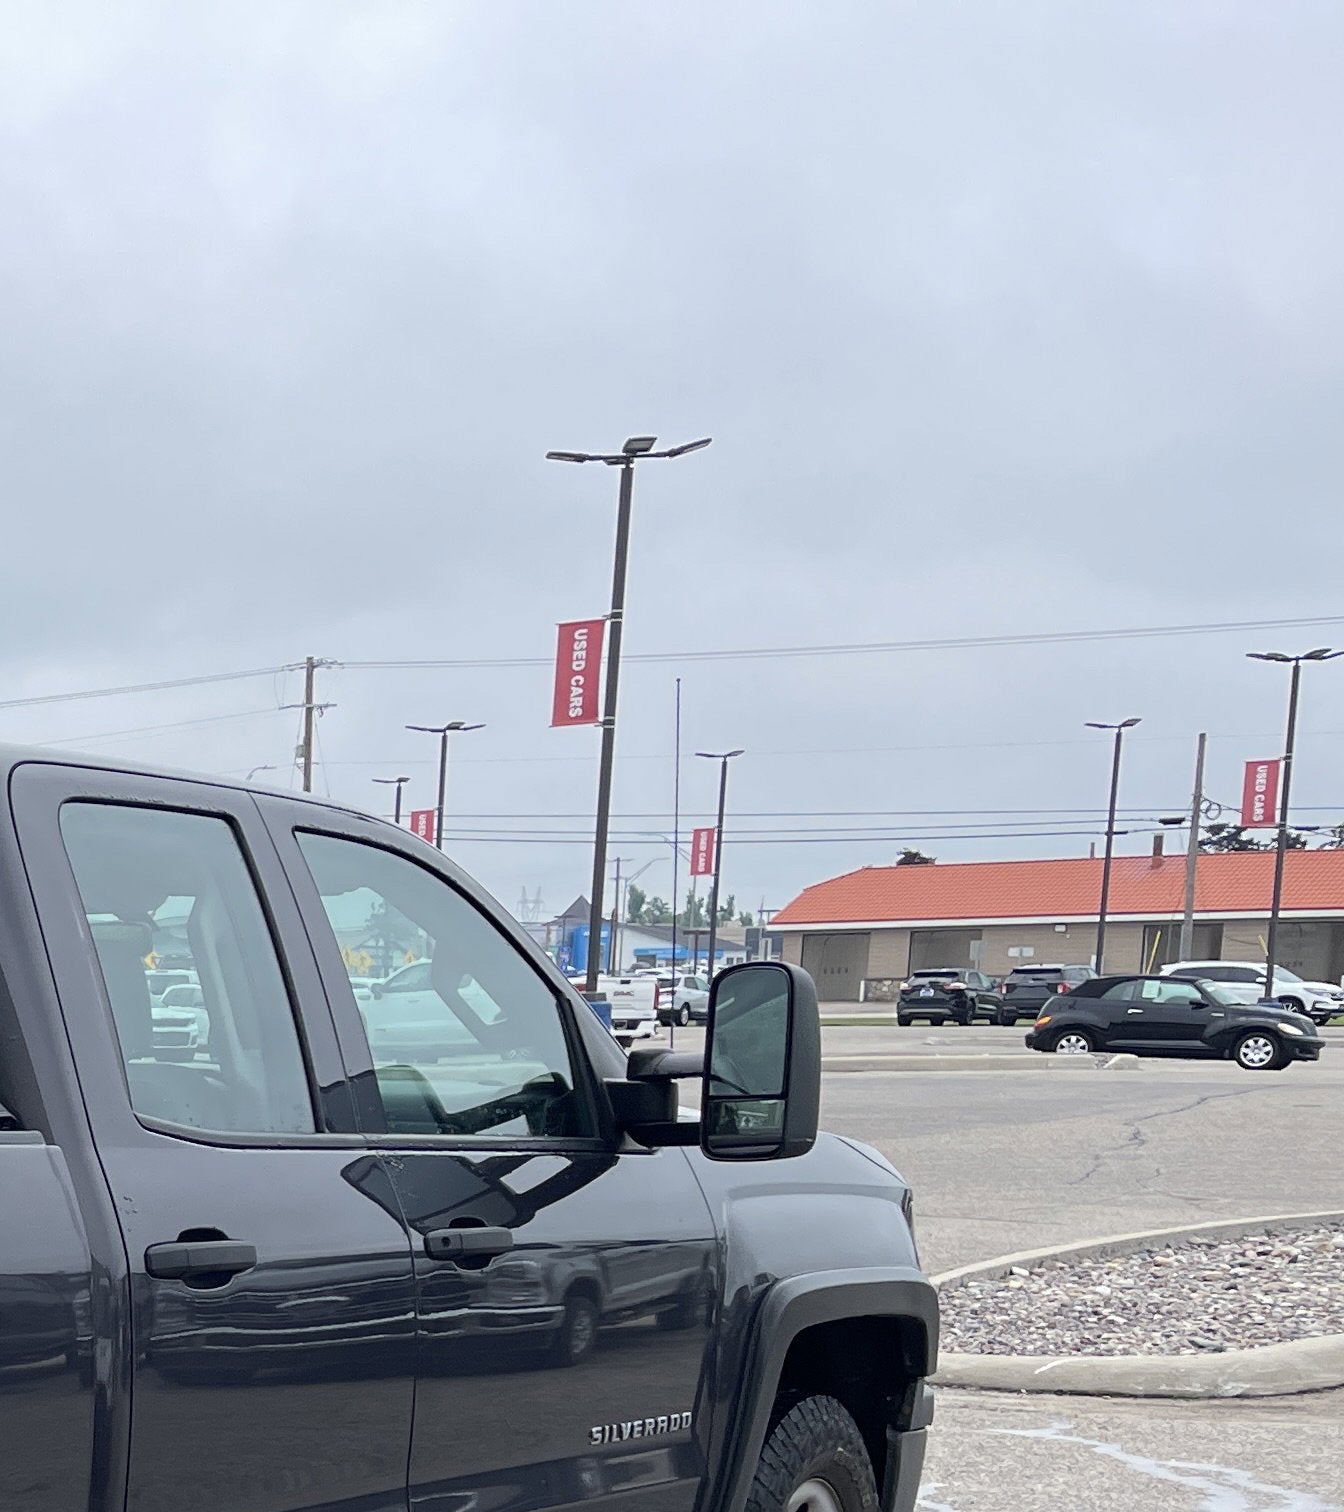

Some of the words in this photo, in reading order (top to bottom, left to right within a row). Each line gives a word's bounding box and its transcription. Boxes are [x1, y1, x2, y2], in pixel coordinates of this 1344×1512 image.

[572, 628, 588, 672] USED
[568, 675, 584, 718] CARS
[1255, 765, 1269, 792] USED
[1253, 794, 1266, 822] CARS
[418, 814, 427, 837] USED
[699, 831, 708, 851] USED
[590, 1411, 692, 1445] SILVERADO
